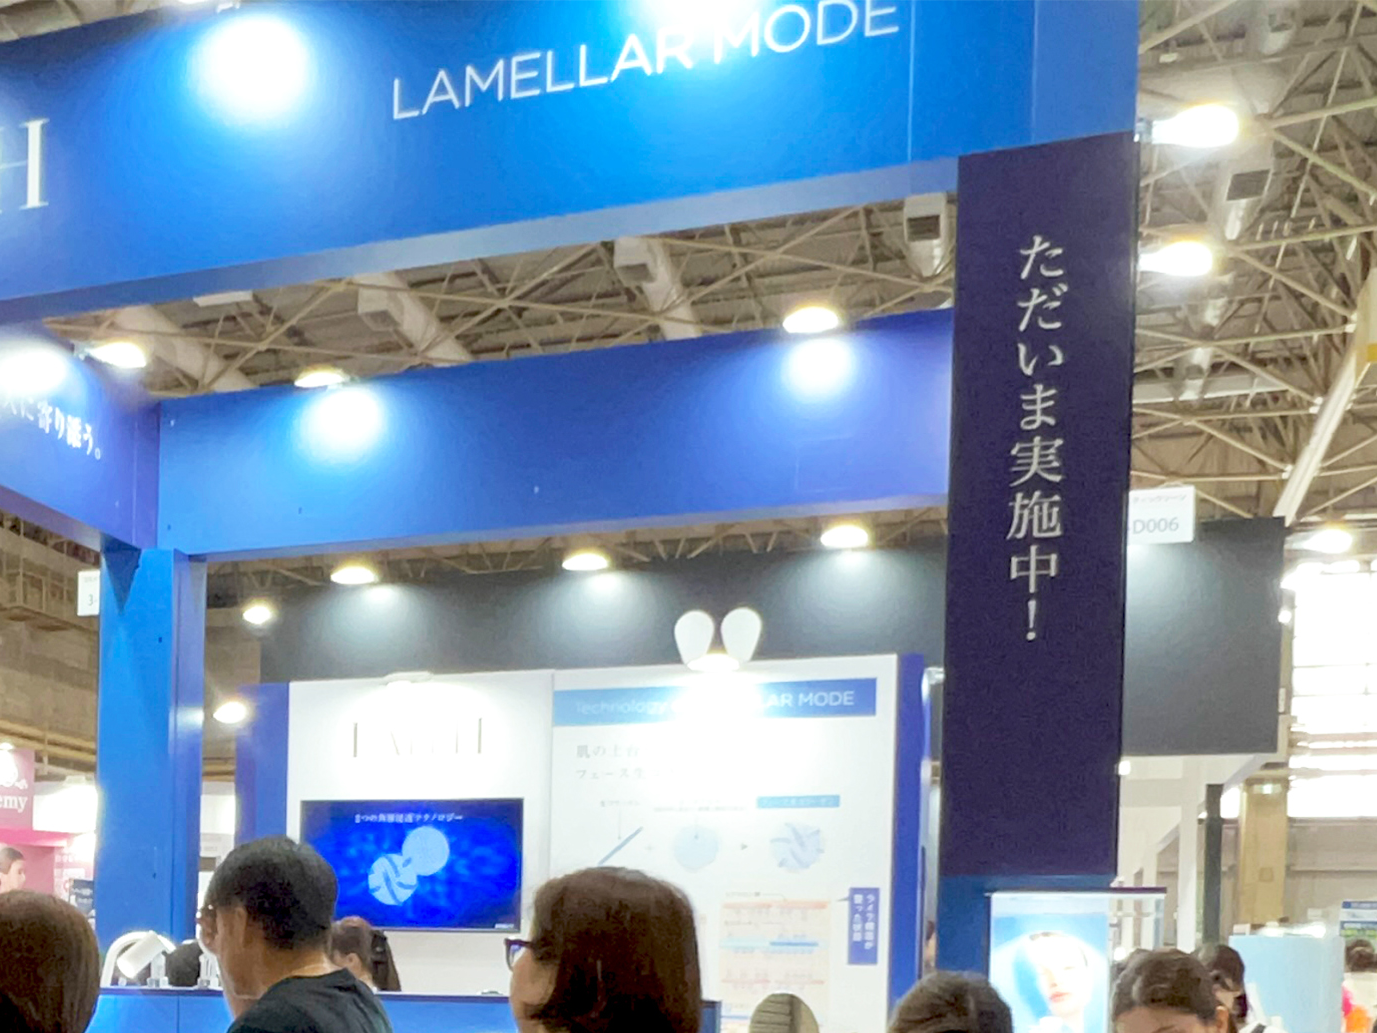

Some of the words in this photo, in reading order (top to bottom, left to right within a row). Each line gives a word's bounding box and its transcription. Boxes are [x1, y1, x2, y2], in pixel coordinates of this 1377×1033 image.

[393, 28, 694, 120] LAMELLAR
[713, 0, 900, 64] MODE
[1006, 234, 1068, 641] ただいま実施中！
[797, 690, 855, 707] MODE
